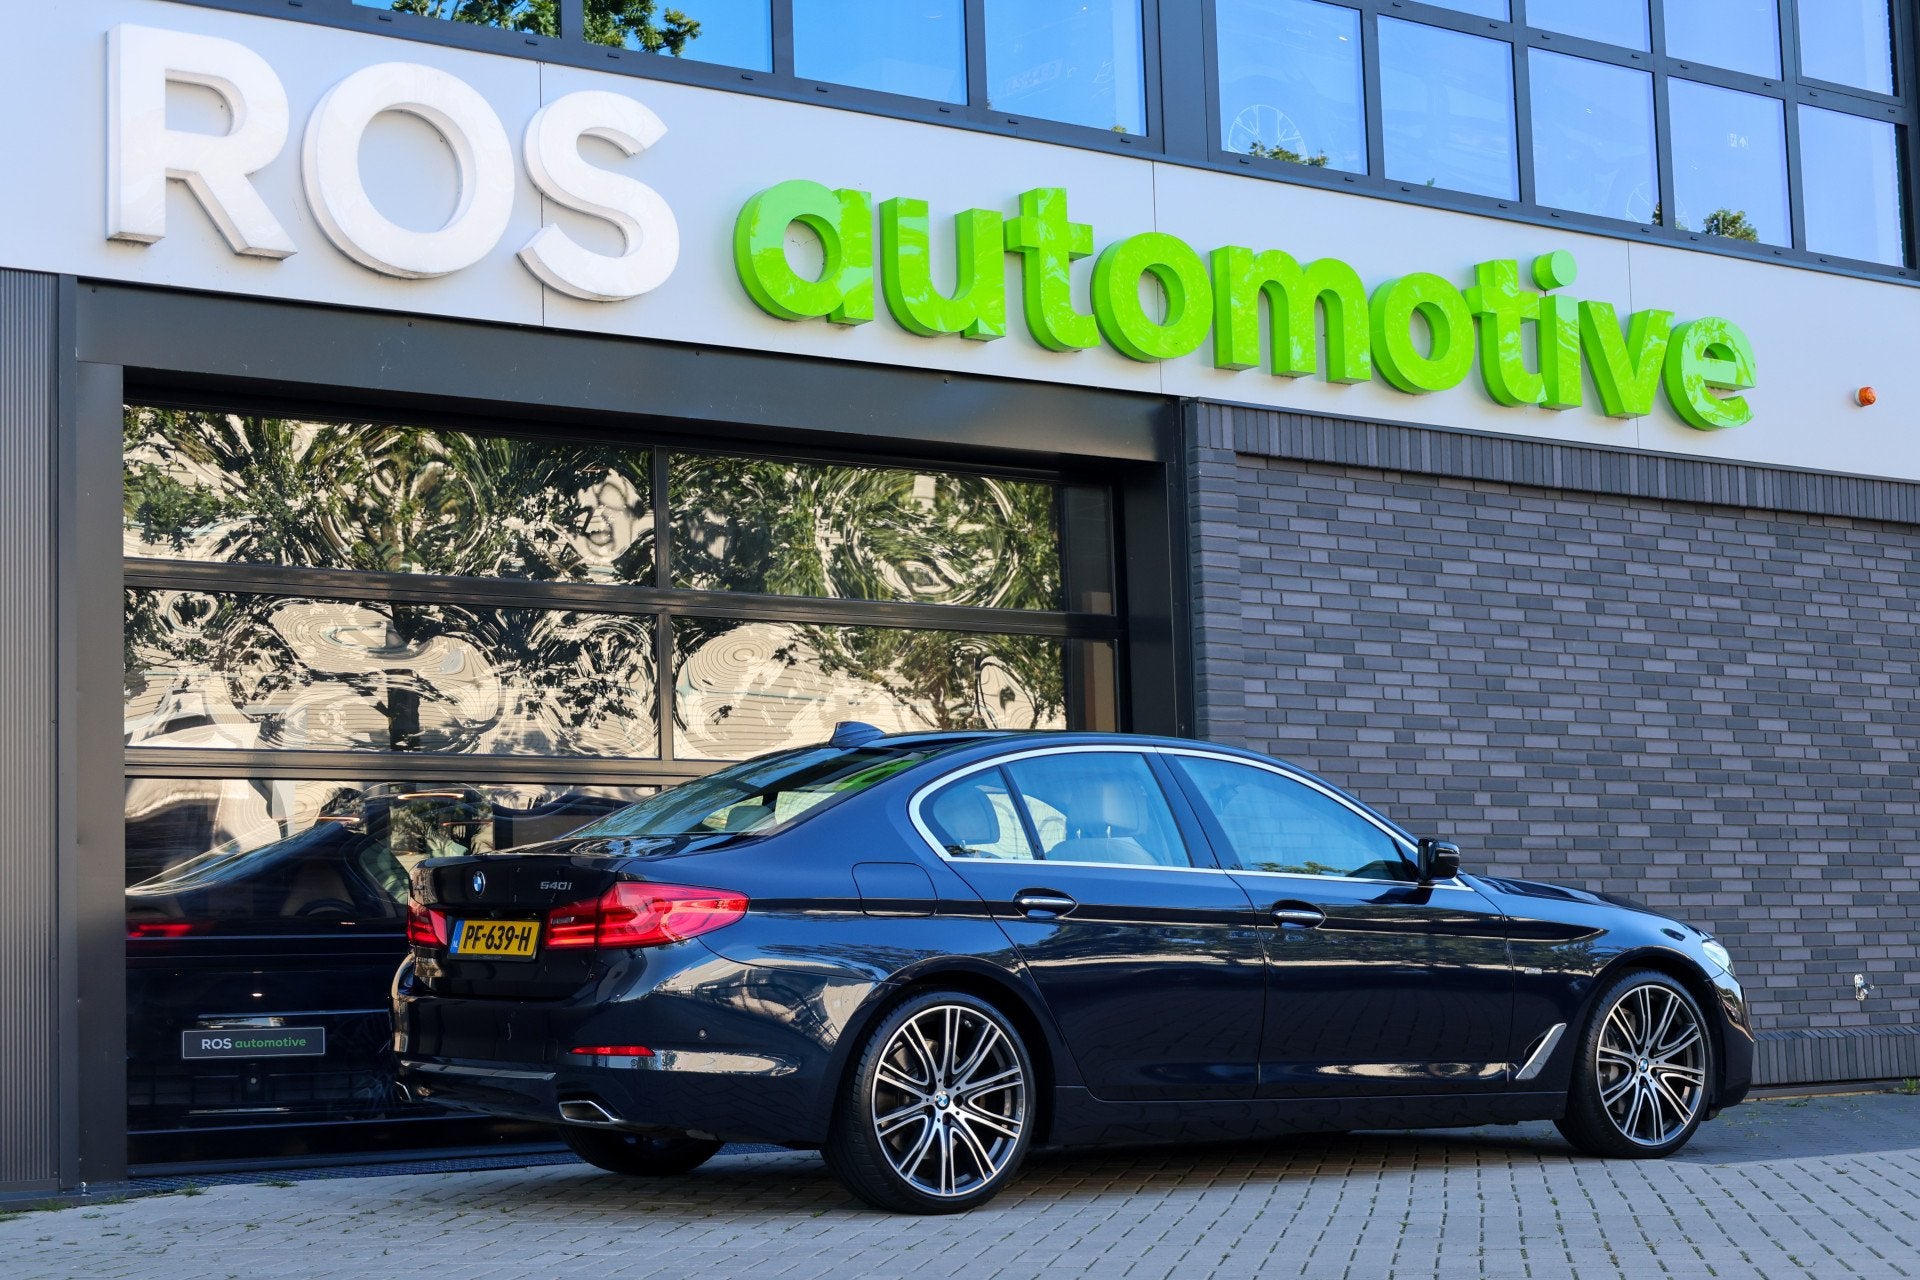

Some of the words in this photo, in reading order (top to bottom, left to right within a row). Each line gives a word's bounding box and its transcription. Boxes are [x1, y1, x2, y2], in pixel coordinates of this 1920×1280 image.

[105, 22, 681, 303] ROS
[733, 178, 1757, 432] automotive
[540, 881, 573, 891] 540i
[463, 924, 532, 952] PF-639-H
[201, 1037, 232, 1050] ROS
[235, 1036, 307, 1049] automotive
